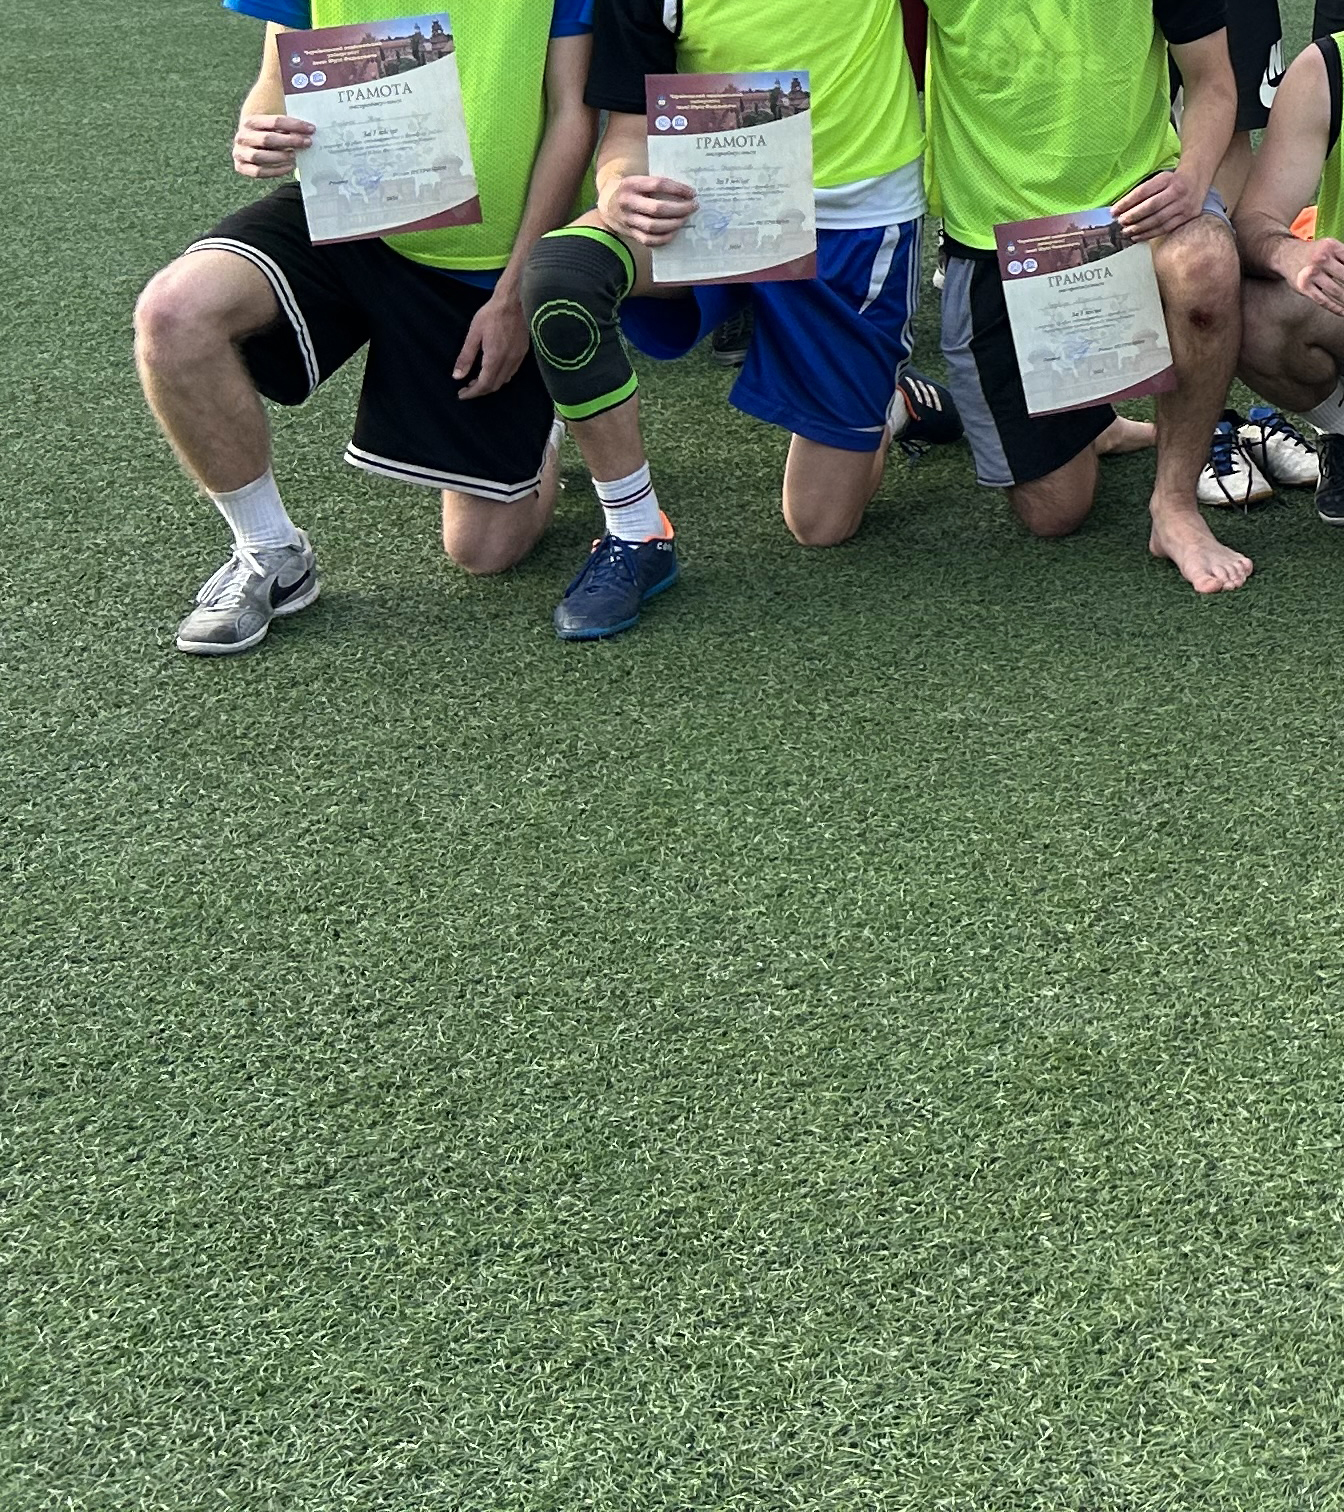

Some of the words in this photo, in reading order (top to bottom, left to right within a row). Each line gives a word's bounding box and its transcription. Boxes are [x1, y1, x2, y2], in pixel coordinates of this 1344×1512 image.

[338, 82, 412, 103] ГРАМОТА
[696, 135, 767, 149] ГРАМОТА
[1048, 267, 1113, 287] ГРАМОТА
